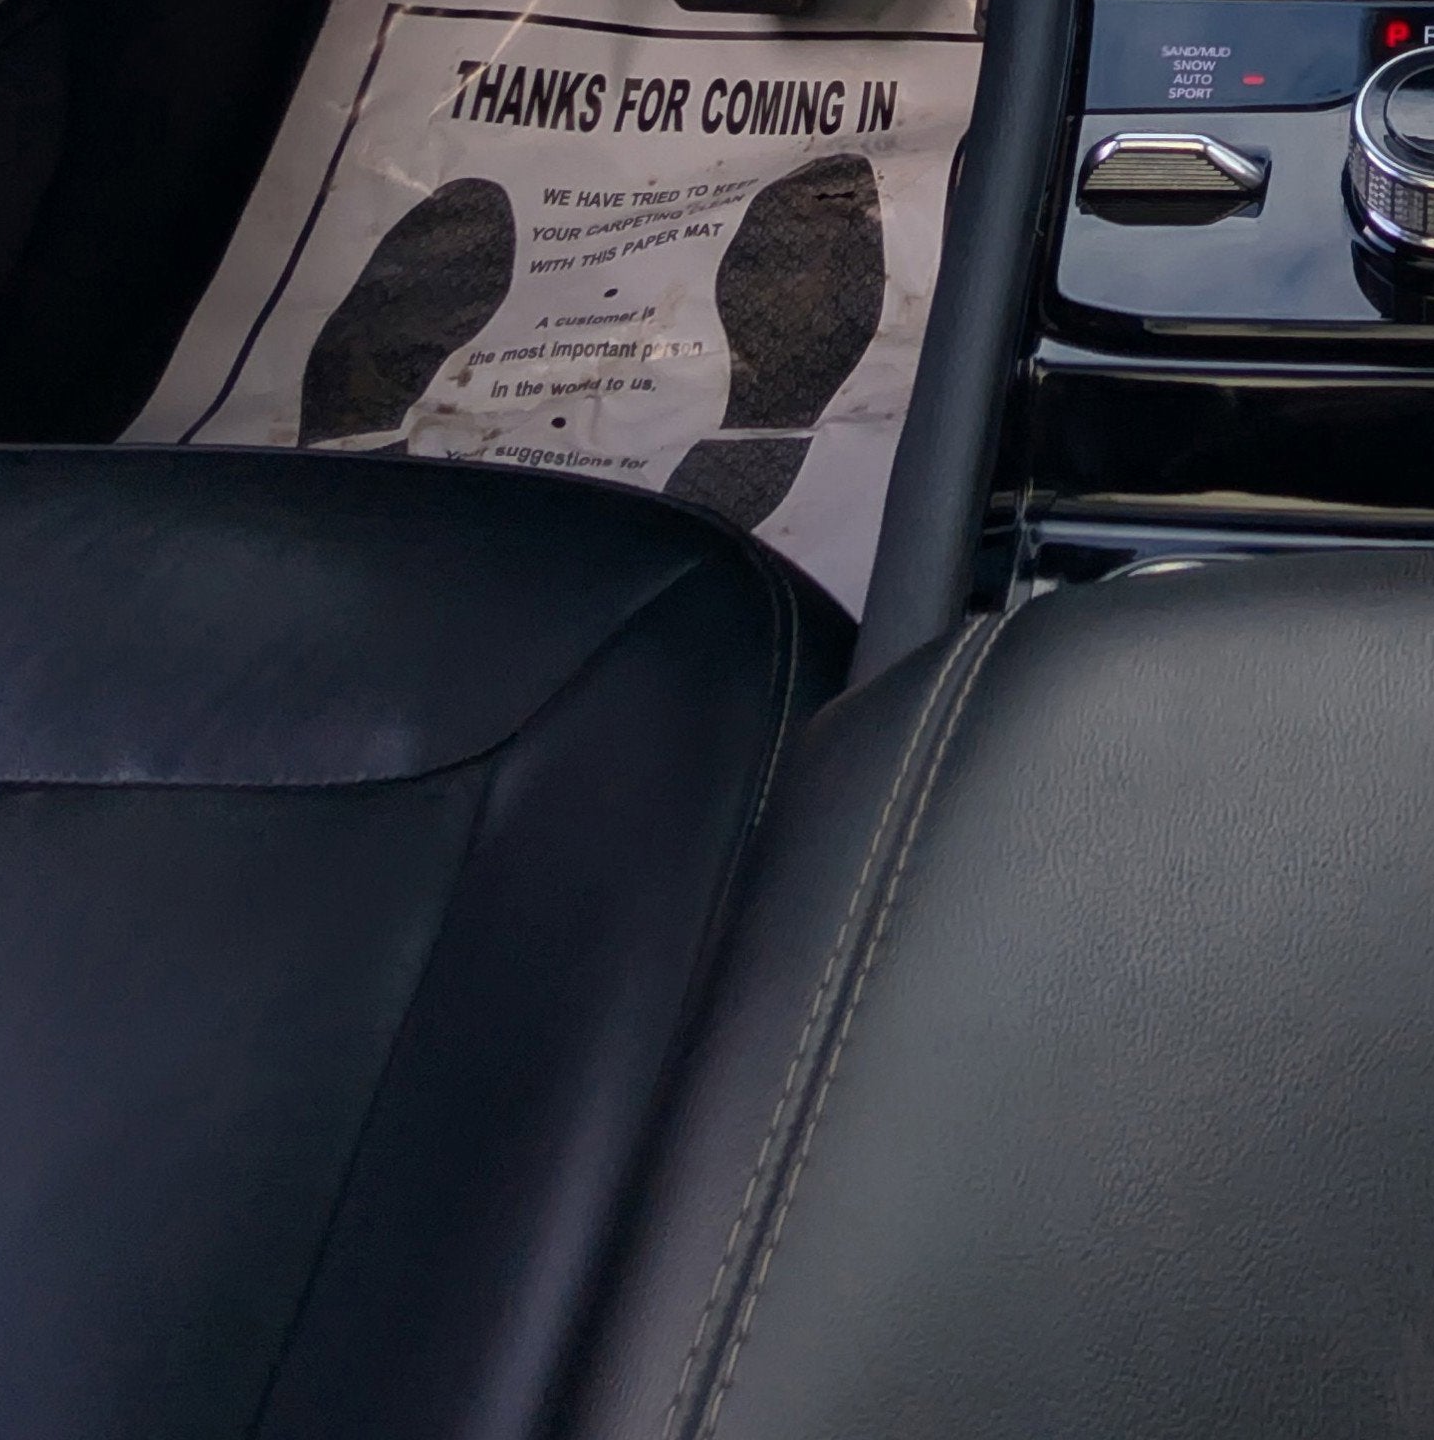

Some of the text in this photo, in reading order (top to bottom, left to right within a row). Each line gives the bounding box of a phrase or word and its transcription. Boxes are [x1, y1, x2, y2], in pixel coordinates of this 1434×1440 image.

[1385, 19, 1411, 48] P
[1161, 45, 1231, 58] SAND/MUD
[1173, 60, 1216, 71] SNOW
[1173, 73, 1213, 85] AUTO
[450, 60, 898, 136] THANKS FOR COMING IN
[1168, 87, 1214, 99] SPORT
[542, 187, 571, 207] WE
[576, 190, 625, 209] HAVE
[631, 189, 680, 207] TRIED
[686, 184, 708, 200] TO
[531, 226, 583, 243] YOUR
[585, 210, 683, 237] CARPETING
[529, 221, 725, 275] WITH THIS PAPER MAT
[534, 306, 656, 330] A customer is
[467, 349, 496, 367] the
[500, 344, 546, 362] most
[550, 340, 637, 361] important
[491, 381, 509, 399] in
[515, 379, 545, 398] the
[551, 378, 601, 398] world
[606, 377, 626, 392] to
[494, 445, 614, 468] suggestions
[619, 456, 649, 470] for
